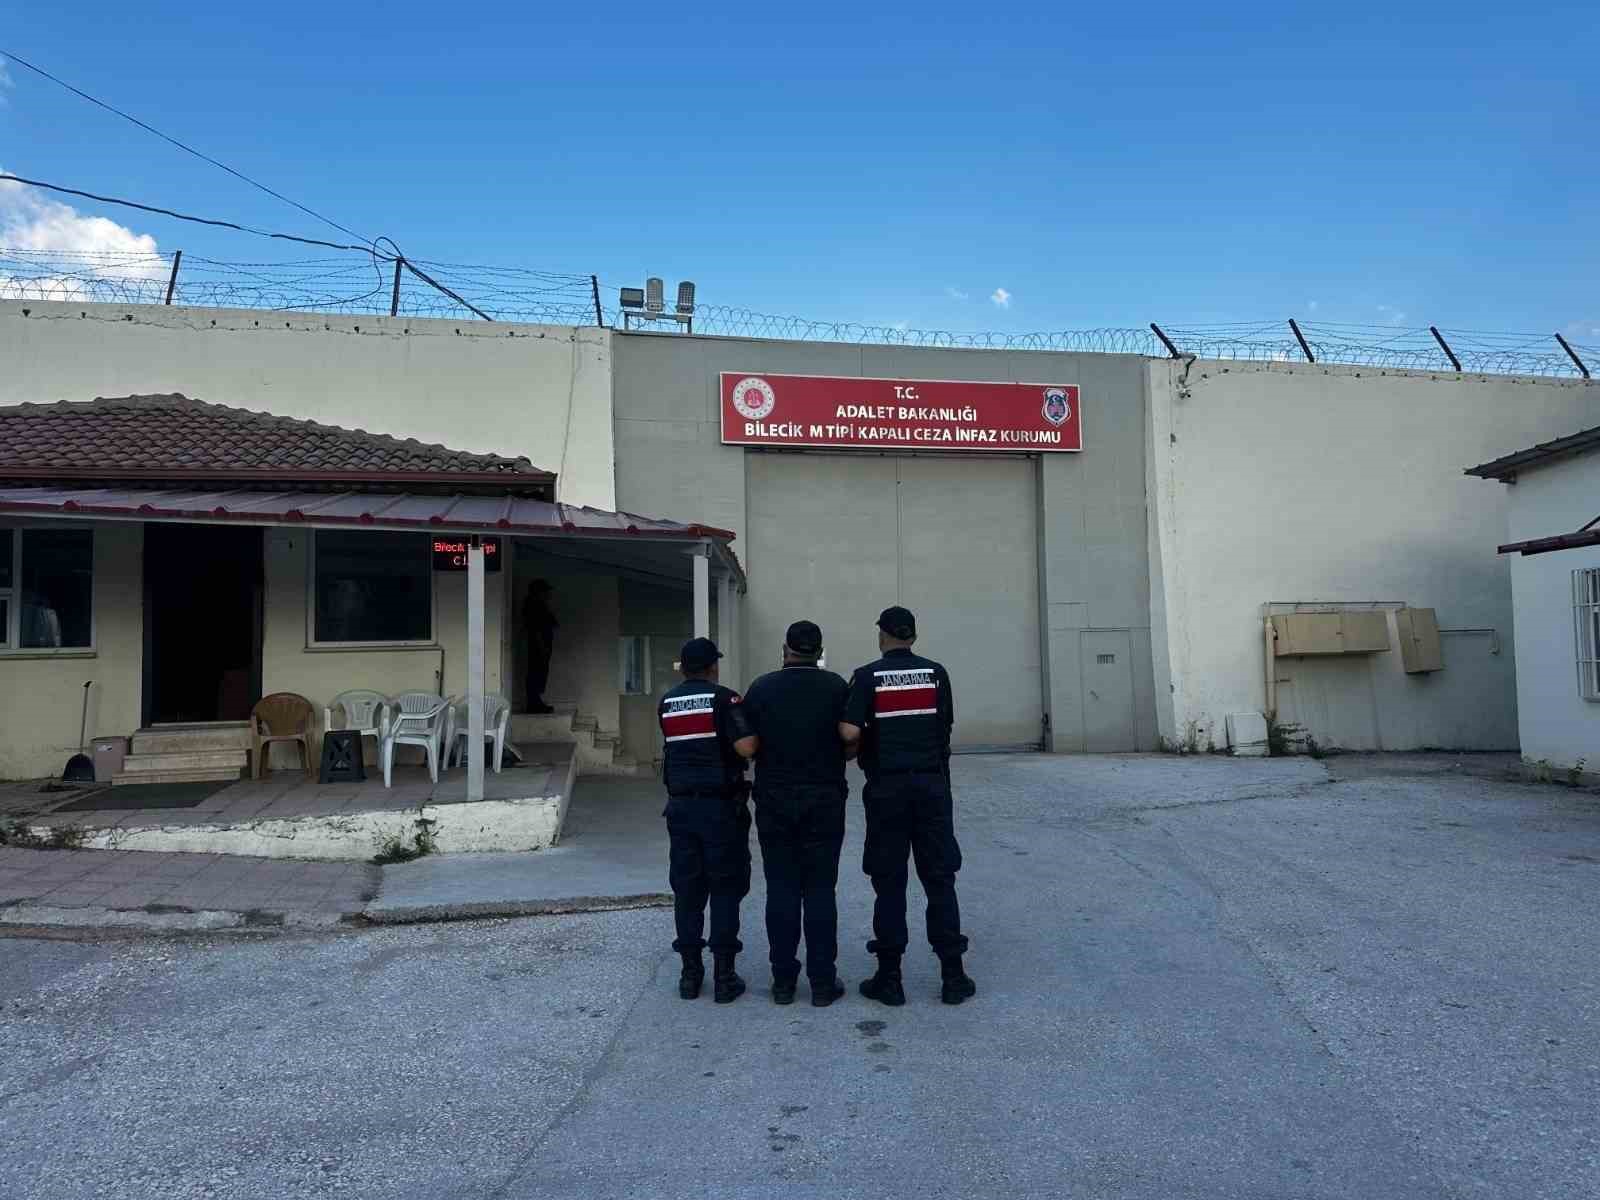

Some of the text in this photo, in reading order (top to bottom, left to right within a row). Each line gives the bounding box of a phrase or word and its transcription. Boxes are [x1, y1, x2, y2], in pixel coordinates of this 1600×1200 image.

[894, 386, 919, 399] T.C.
[836, 404, 977, 421] ADALET BAKANLIĞI
[744, 420, 804, 438] BİLECİK
[809, 424, 823, 438] M
[858, 426, 910, 440] KAPALI
[913, 427, 952, 441] CEZA
[955, 426, 998, 442] İNFAZ
[1000, 430, 1061, 444] KURUMU
[881, 673, 931, 687] JANDARMA
